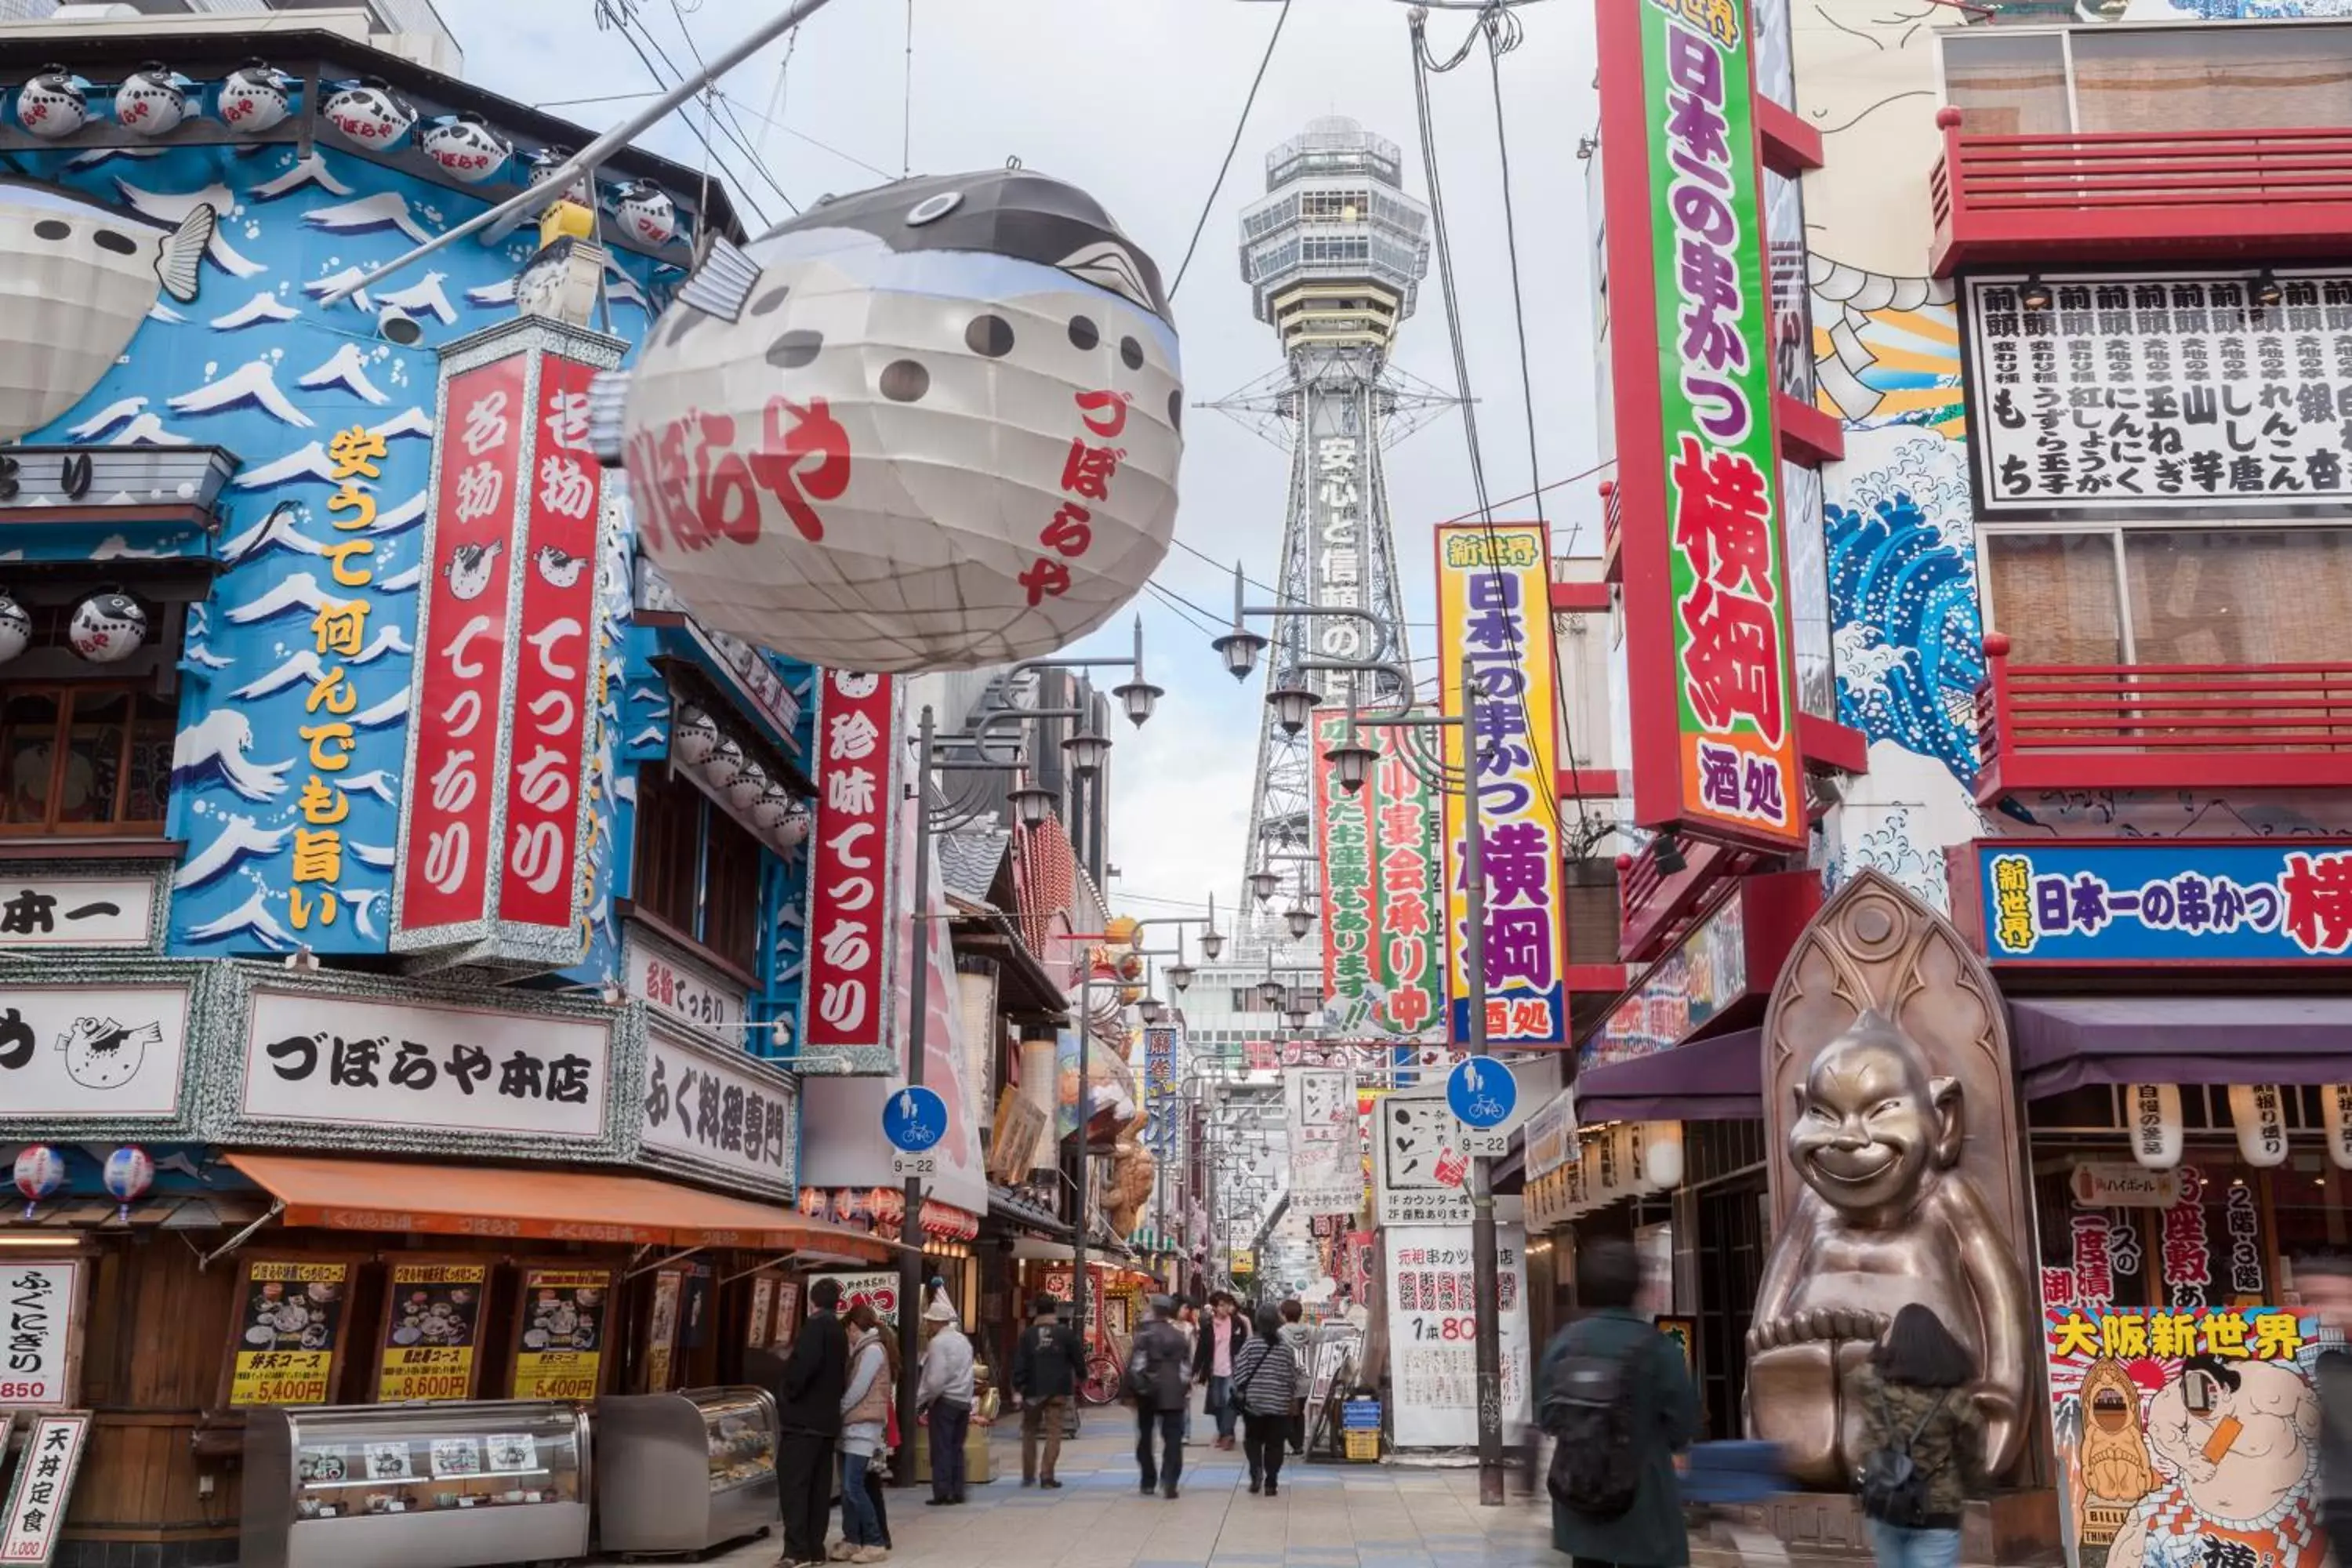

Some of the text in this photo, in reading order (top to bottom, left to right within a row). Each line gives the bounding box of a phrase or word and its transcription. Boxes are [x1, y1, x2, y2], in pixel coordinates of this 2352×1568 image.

[1984, 287, 2020, 338] 前頭
[2058, 285, 2096, 337] 前頭
[2096, 285, 2133, 336] 前頭
[2134, 285, 2171, 336] 前頭
[2171, 284, 2209, 336] 前頭
[2209, 283, 2247, 336] 前頭
[2285, 281, 2322, 334] 前頭
[1669, 24, 1782, 748] 日本一の串かつ 横綱
[1994, 389, 2031, 495] もち
[2032, 387, 2074, 493] うずら玉子
[2068, 387, 2112, 494] 紅しょうが
[2105, 389, 2146, 494] にんにく
[2145, 387, 2190, 495] 玉ねぎ
[2183, 385, 2225, 492] 山芋
[2222, 384, 2264, 492] しし唐
[2259, 383, 2304, 492] れんこん
[2296, 383, 2343, 490] 銀杏
[1448, 535, 1537, 567] 新世界
[289, 426, 387, 931] 安うて何んでも旨い
[425, 390, 508, 894] 名物 てっちり
[513, 619, 583, 894] てっちり
[1456, 573, 1552, 989] 日本一の串かつ 横綱
[1703, 745, 1782, 820] 酒処
[819, 710, 879, 1033] 珍味てっちり
[1997, 859, 2033, 948] 新世界
[2038, 876, 2276, 930] 日本一の串かつ
[267, 1031, 591, 1104] づぼらや本店
[894, 1160, 935, 1174] 9-22
[1461, 1138, 1505, 1152] 9-22
[1397, 1249, 1514, 1265] 元祖串カツ店
[9, 1270, 53, 1373] ふぐにぎり
[2053, 1313, 2303, 1360] 大阪新世界
[258, 1381, 325, 1401] 5,400円
[403, 1376, 466, 1396] 8,600円
[22, 1428, 71, 1533] 天丼定食
